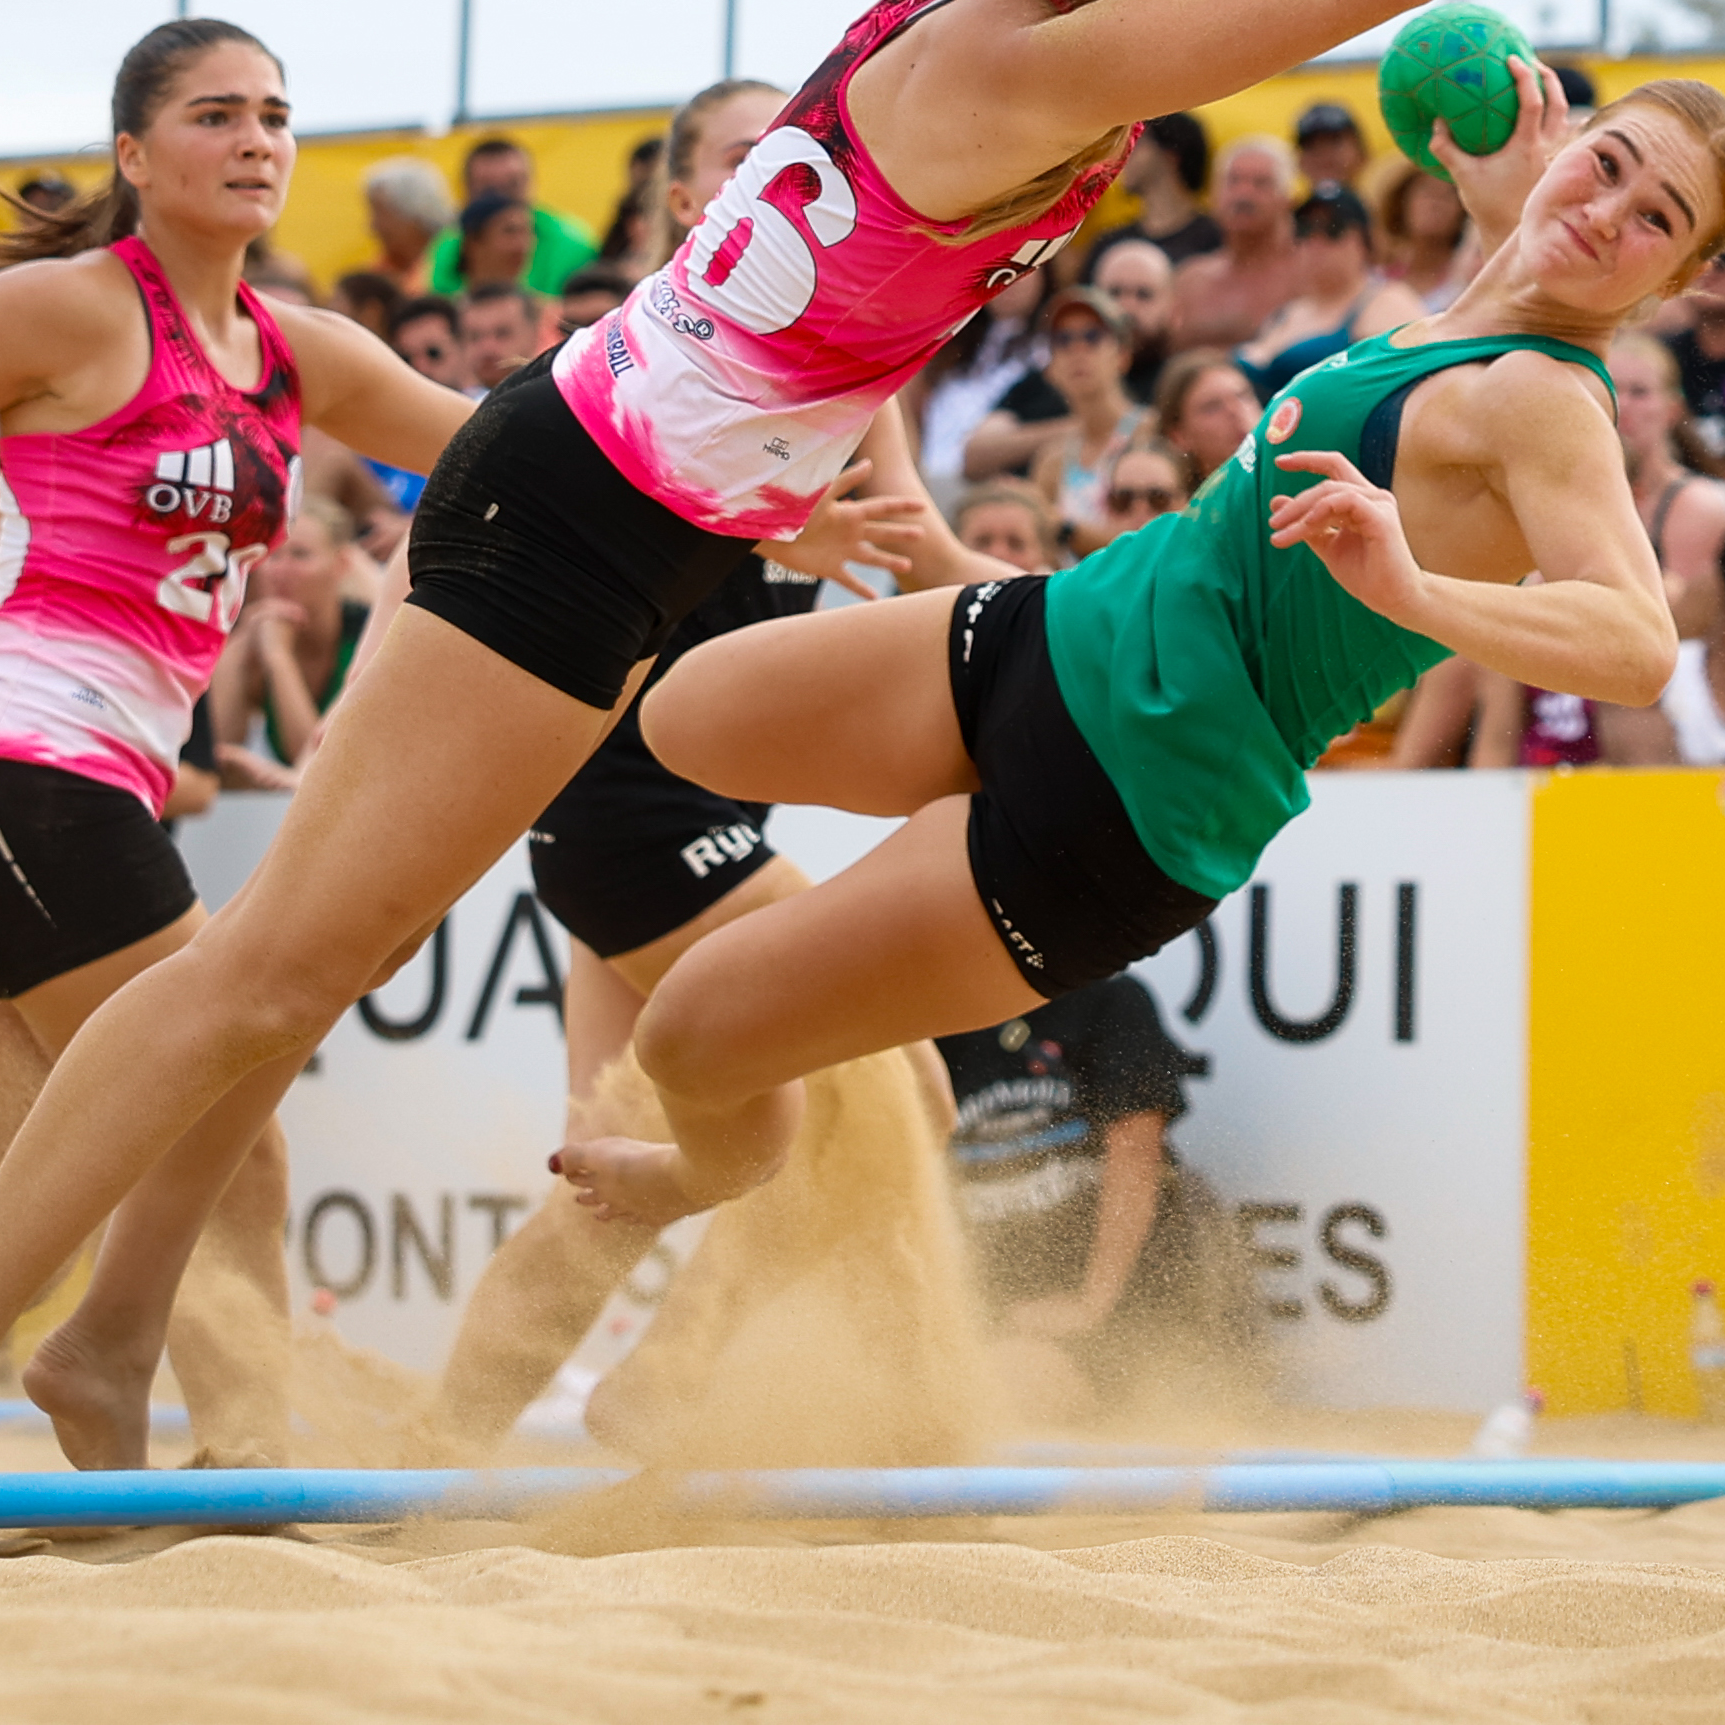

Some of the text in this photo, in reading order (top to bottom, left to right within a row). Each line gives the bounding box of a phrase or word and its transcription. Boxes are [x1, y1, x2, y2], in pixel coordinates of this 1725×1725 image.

[683, 125, 858, 336] 6
[146, 483, 234, 524] OVB
[1237, 1200, 1394, 1324] ES
